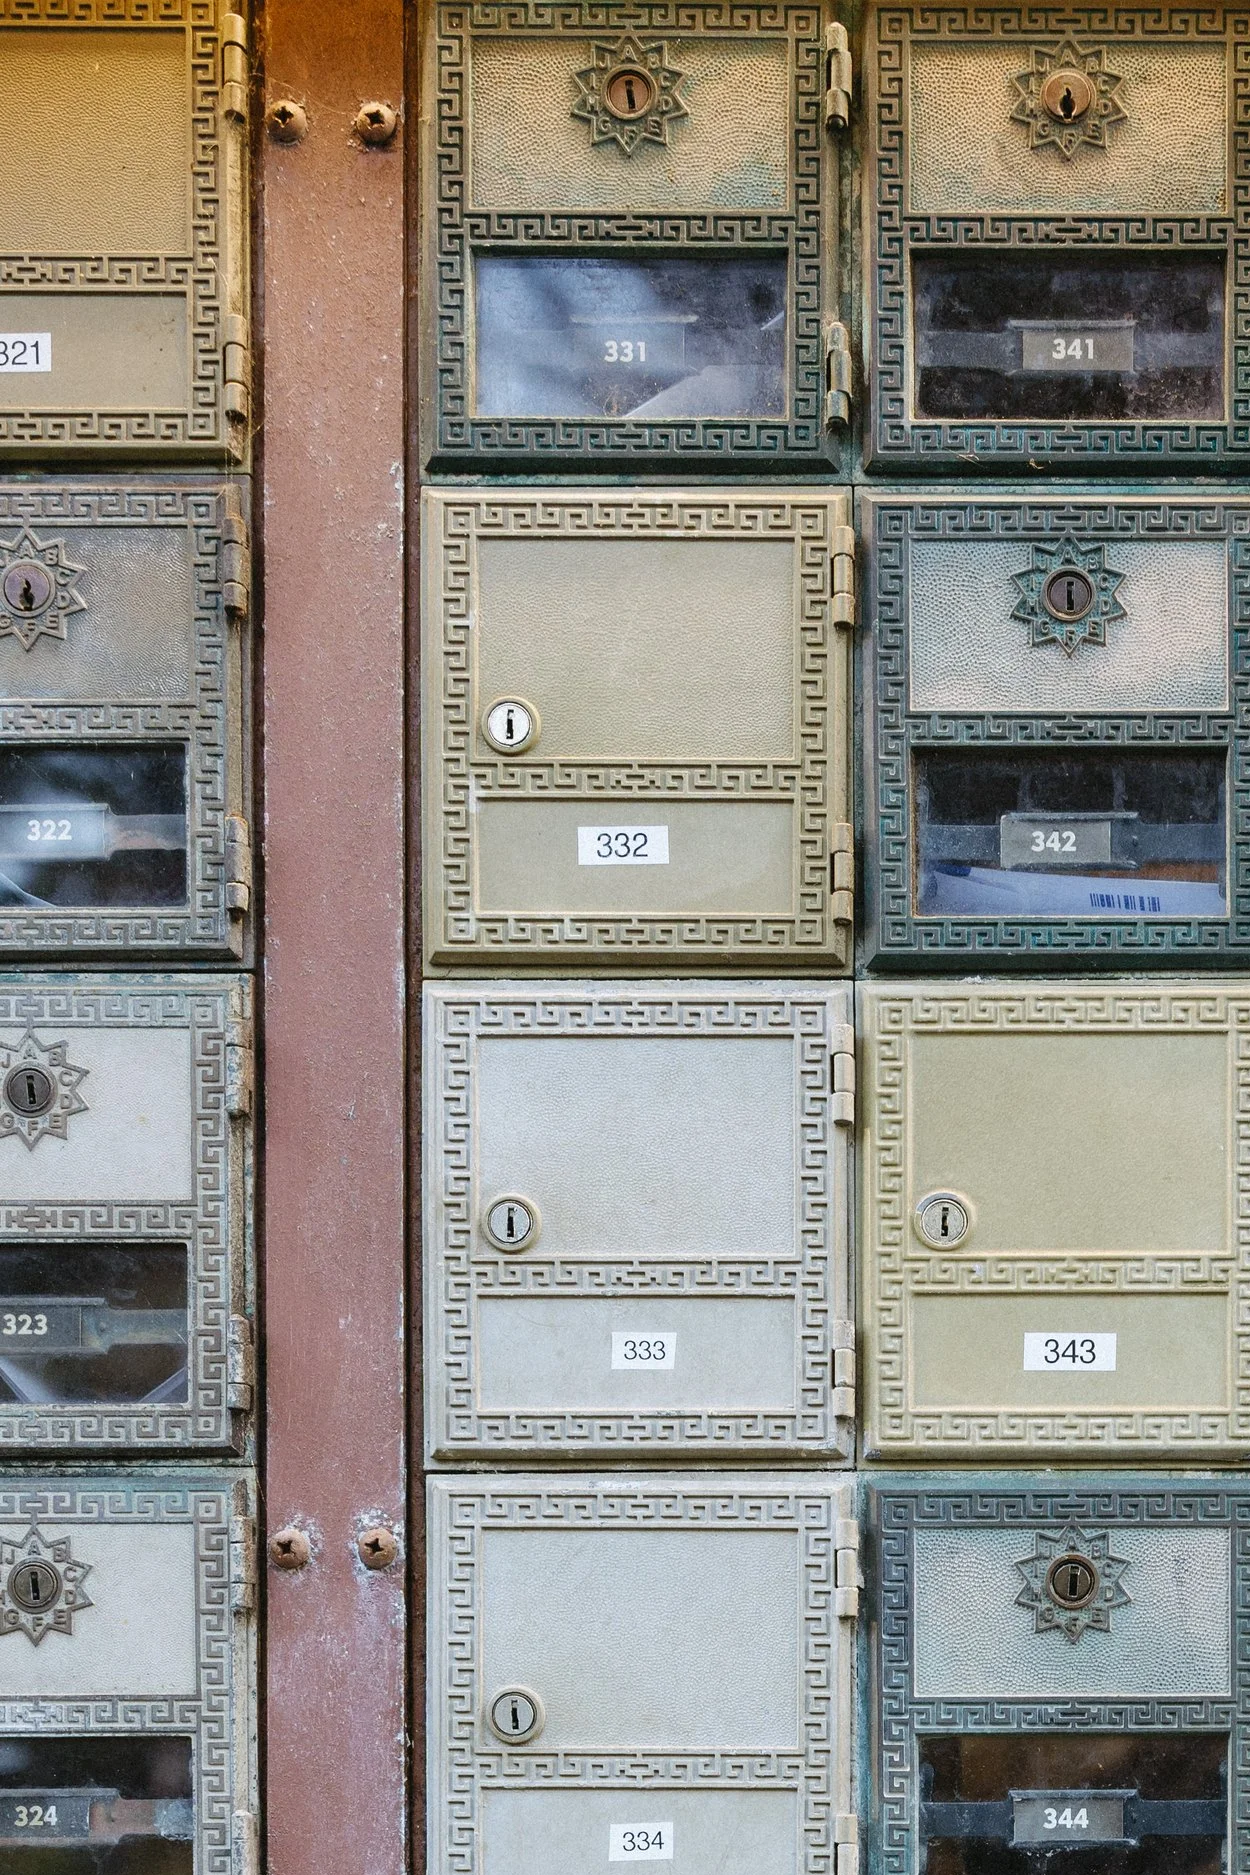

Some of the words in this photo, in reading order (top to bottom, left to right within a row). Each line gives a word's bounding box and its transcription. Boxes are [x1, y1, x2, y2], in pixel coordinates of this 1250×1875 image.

[605, 341, 645, 362] 331
[1052, 339, 1093, 359] 341
[27, 820, 72, 841] 322
[1031, 831, 1076, 851] 342
[597, 833, 648, 857] 332
[3, 1314, 47, 1335] 323
[624, 1341, 665, 1360] 333
[1045, 1339, 1095, 1363] 343
[15, 1806, 57, 1826] 324
[1043, 1808, 1088, 1829] 344
[623, 1831, 664, 1851] 334
